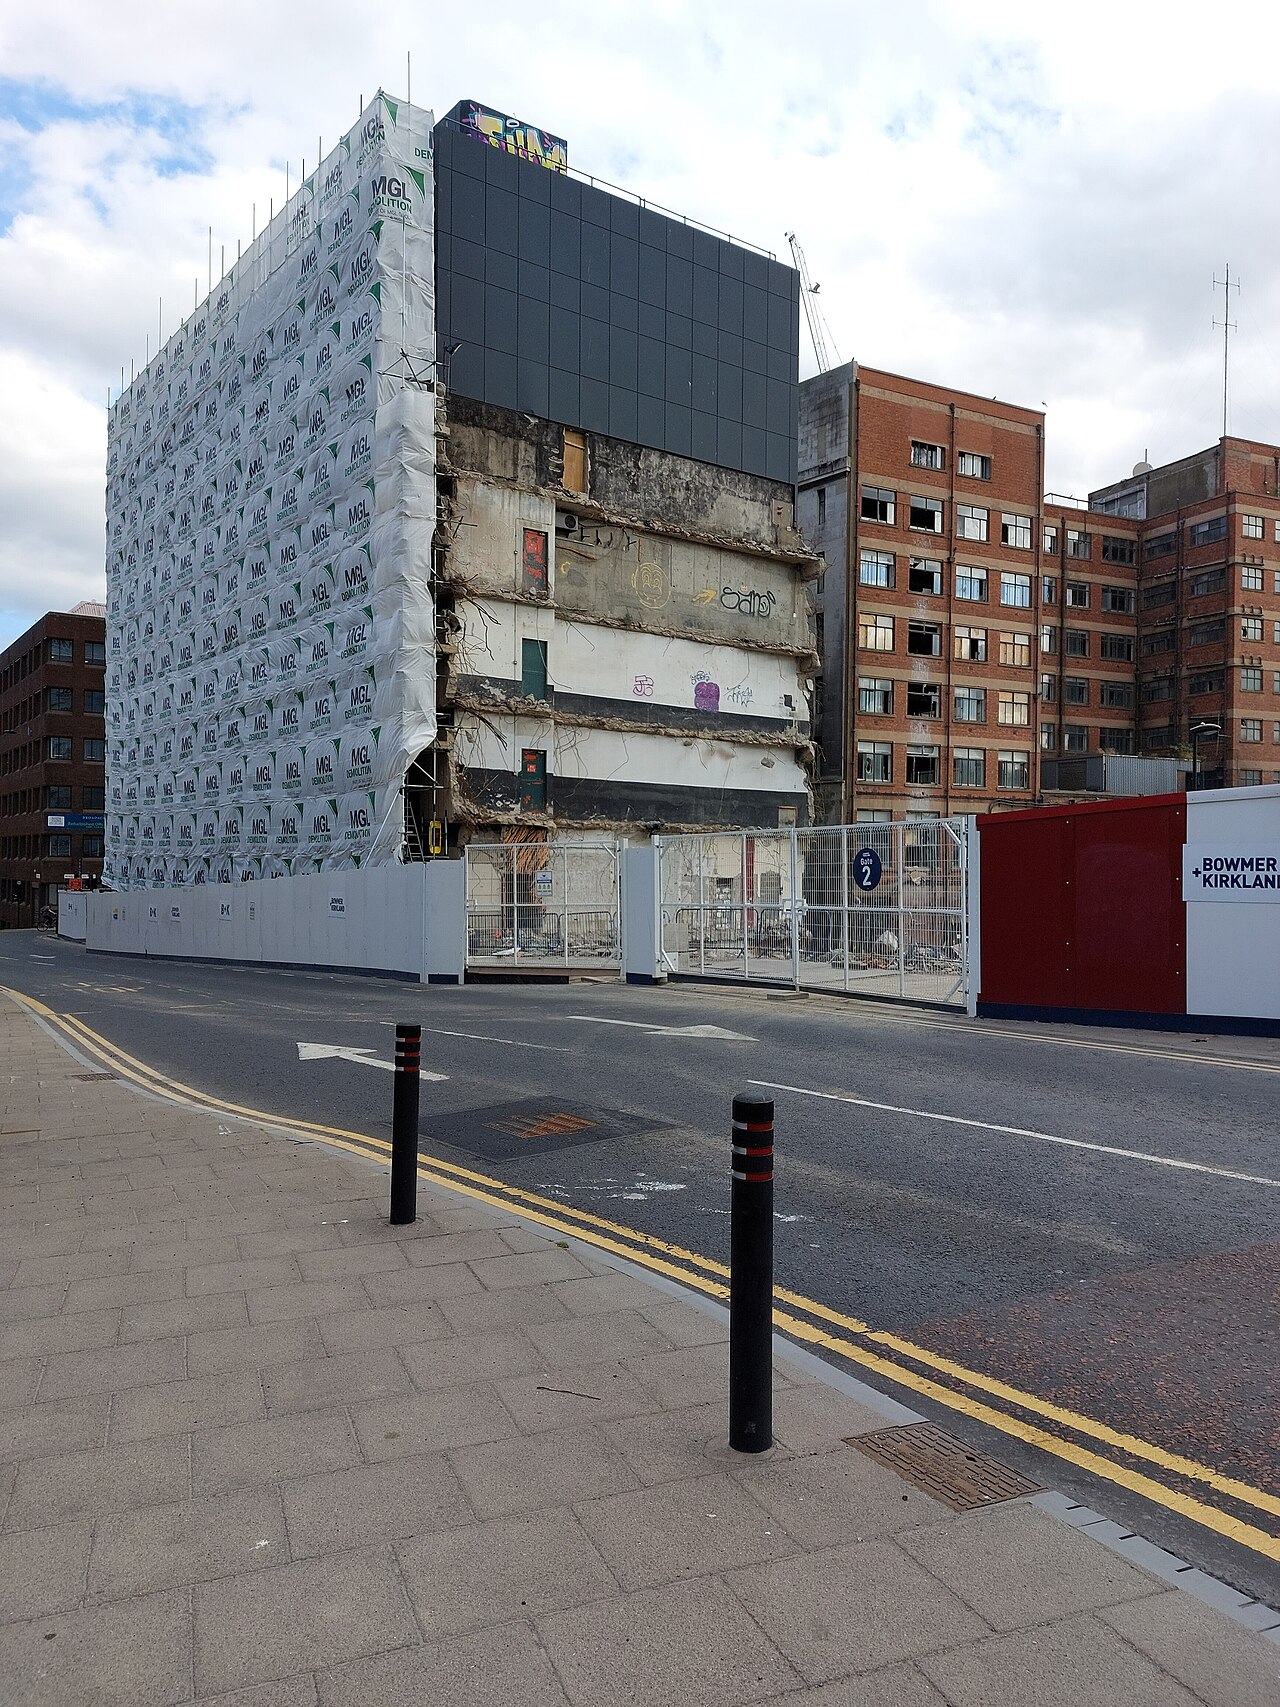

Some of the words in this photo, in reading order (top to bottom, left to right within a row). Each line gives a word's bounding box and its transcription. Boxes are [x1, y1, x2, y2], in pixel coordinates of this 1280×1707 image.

[372, 176, 411, 203] MGL
[351, 248, 371, 280] MGL
[315, 286, 333, 315] MGL
[352, 309, 372, 339] MGL
[316, 343, 332, 373] MGL
[284, 374, 300, 400] MGL
[346, 378, 366, 406] MGL
[309, 408, 325, 435] MGL
[351, 434, 370, 463] MGL
[314, 463, 329, 488] MGL
[282, 487, 297, 510] MGL
[349, 500, 370, 526] MGL
[312, 522, 330, 547] MGL
[281, 544, 297, 565] MGL
[345, 564, 367, 588] MGL
[312, 582, 330, 603] MGL
[280, 600, 296, 620] MGL
[251, 612, 266, 631] MGL
[346, 624, 366, 647] MGL
[313, 640, 328, 661] MGL
[280, 653, 297, 673] MGL
[351, 685, 371, 706] MGL
[283, 708, 298, 726] MGL
[315, 698, 330, 718] MGL
[345, 704, 372, 719] DEMOLITION
[254, 714, 268, 731] MGL
[316, 755, 333, 775] MGL
[352, 745, 370, 766] MGL
[256, 766, 271, 782] MGL
[286, 761, 301, 780] MGL
[347, 765, 372, 778] DEMOLITION
[225, 820, 240, 835] MGL
[252, 819, 267, 834] MGL
[281, 818, 297, 834] MGL
[314, 815, 330, 833] MGL
[351, 809, 370, 828] MGL
[1203, 858, 1277, 871] BOWMER
[862, 866, 872, 886] 2
[1203, 874, 1280, 888] KIRKLAN
